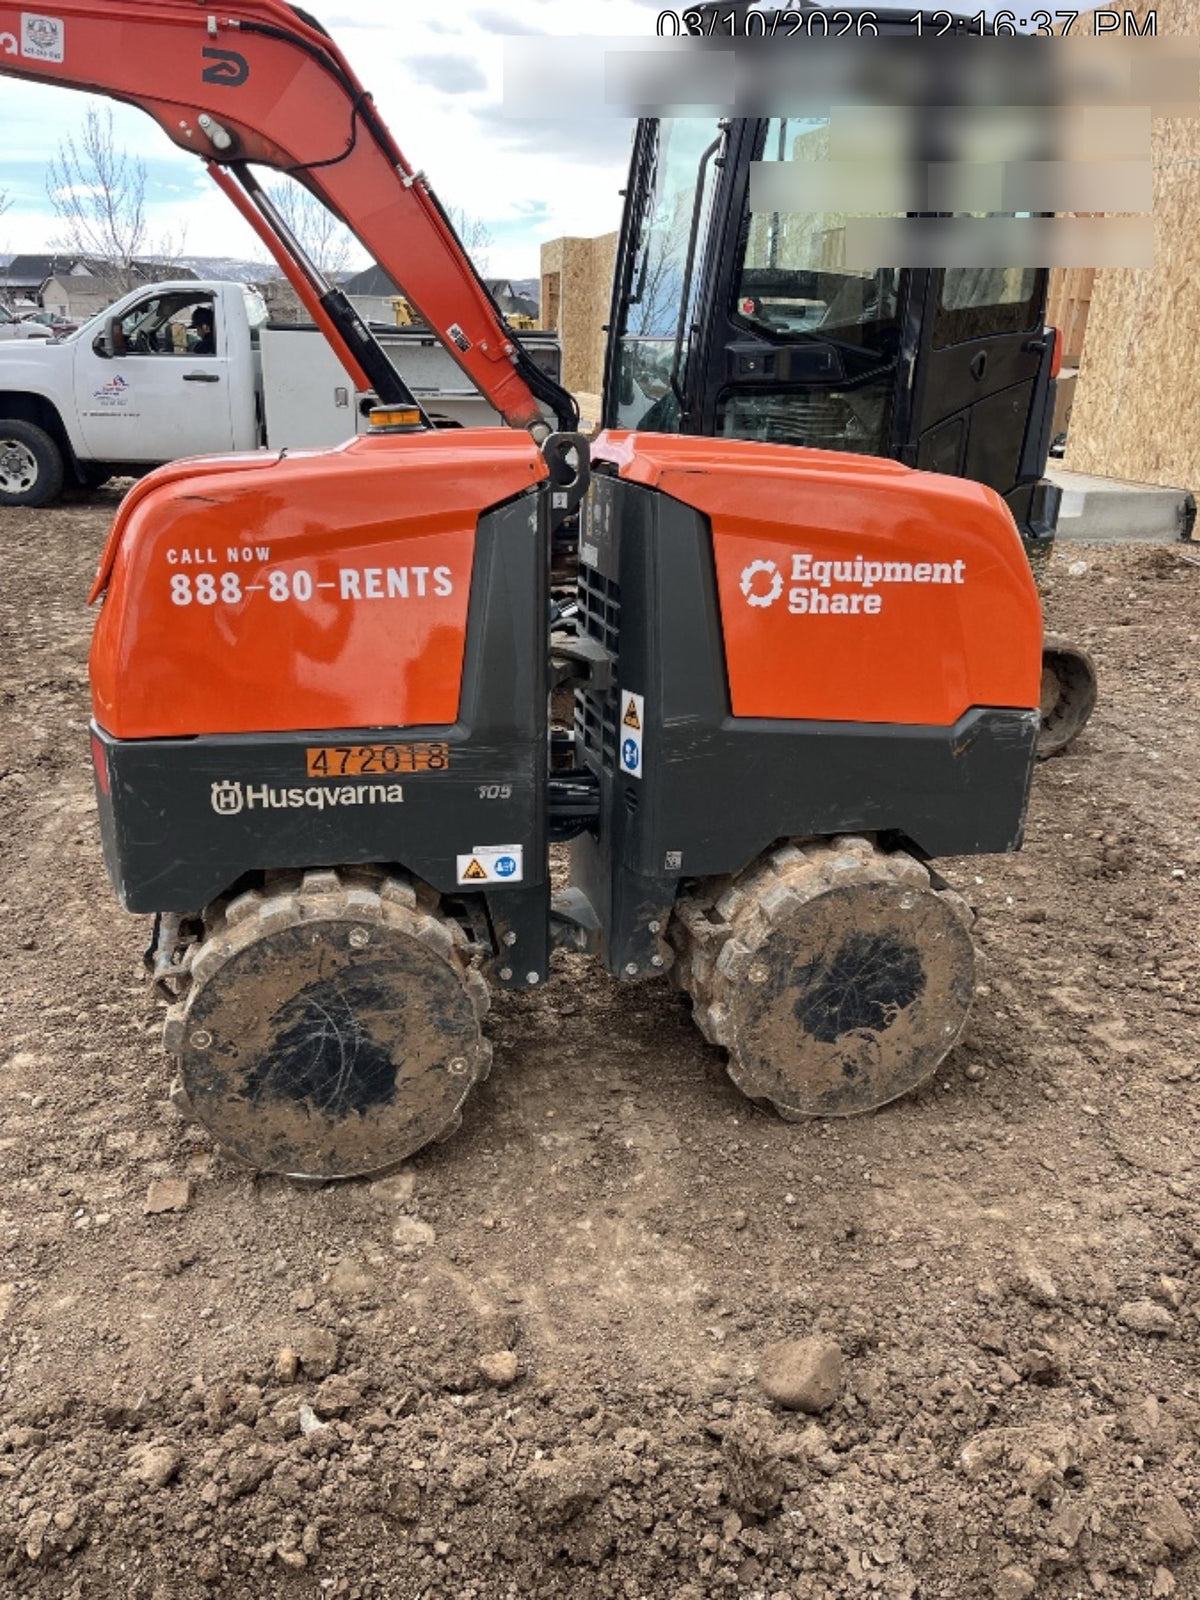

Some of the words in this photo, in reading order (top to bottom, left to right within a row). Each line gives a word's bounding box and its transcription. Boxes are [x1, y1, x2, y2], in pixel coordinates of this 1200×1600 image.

[166, 548, 218, 564] CALL
[227, 546, 271, 562] NOW
[169, 565, 453, 606] 888-80-RENTS
[790, 553, 967, 588] Equipment
[788, 587, 883, 615] Share
[311, 743, 446, 775] 472018
[246, 783, 404, 811] Husqvarna
